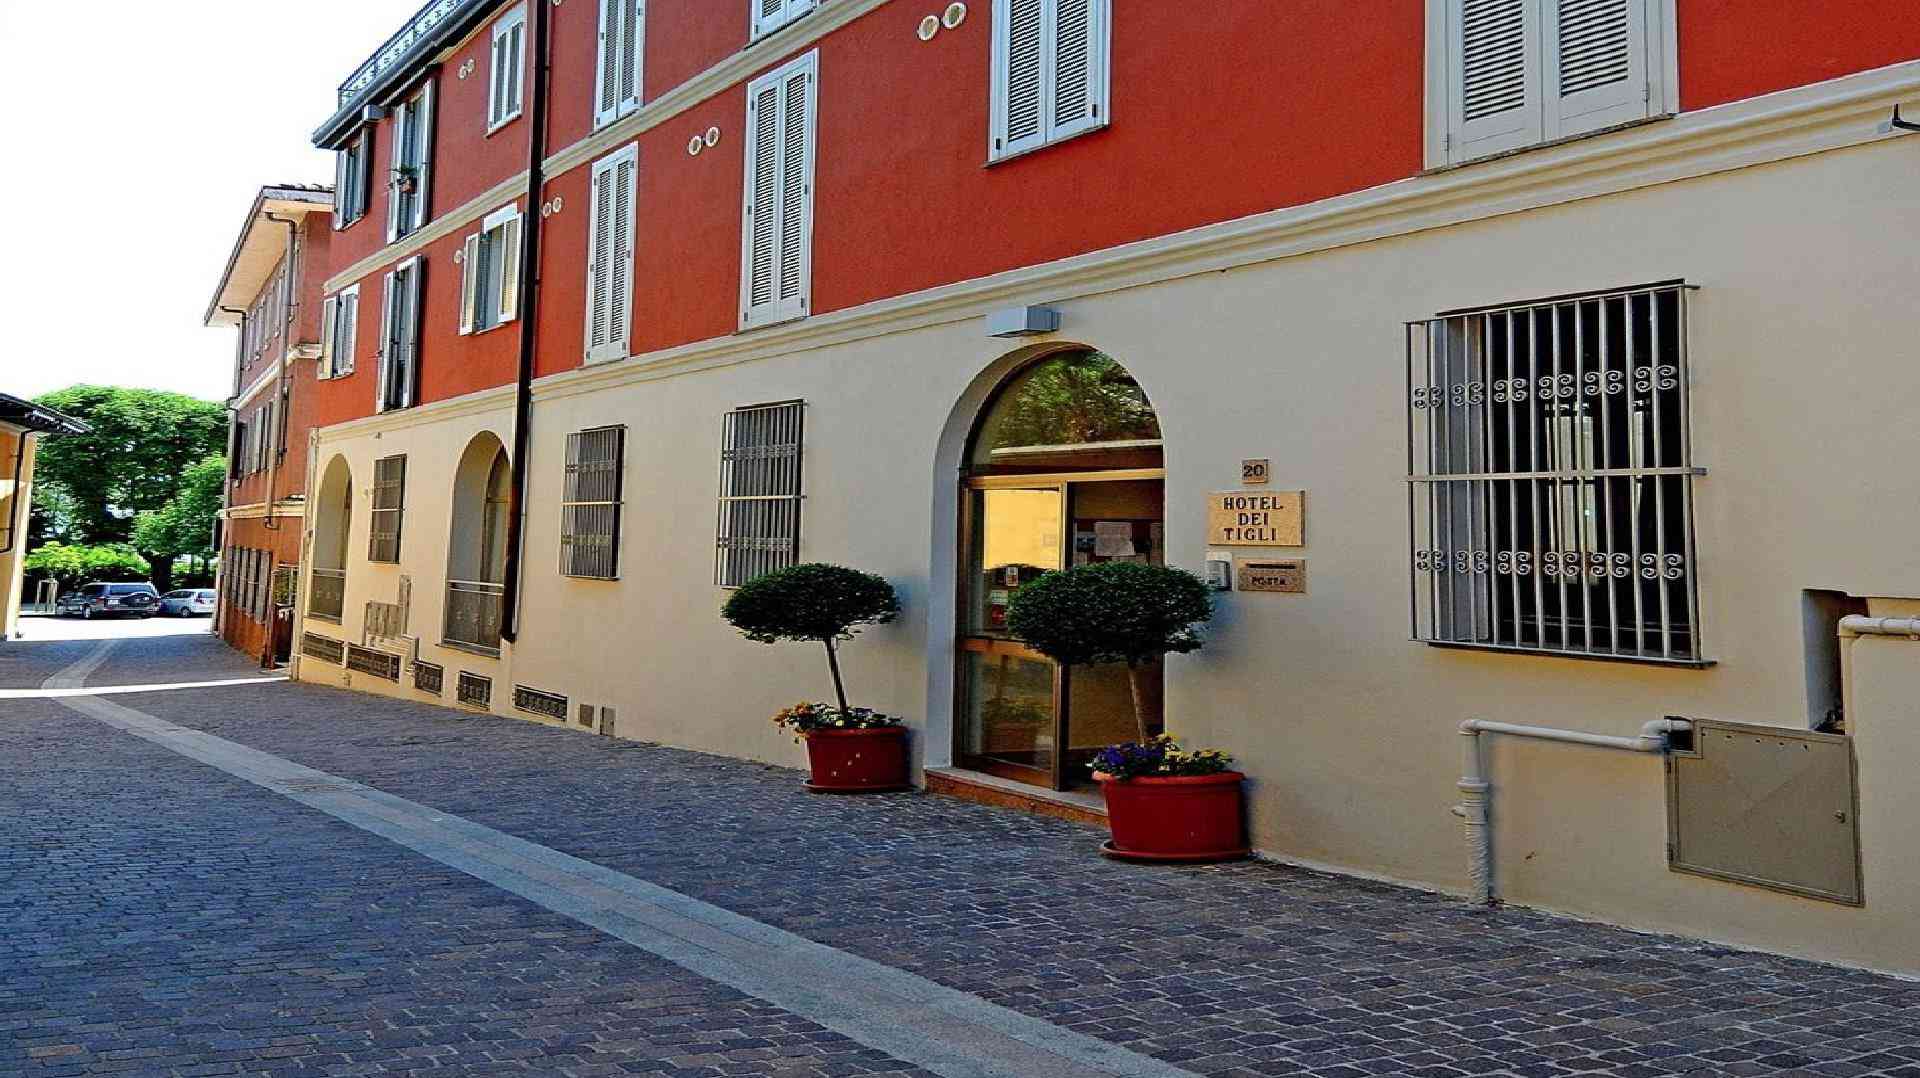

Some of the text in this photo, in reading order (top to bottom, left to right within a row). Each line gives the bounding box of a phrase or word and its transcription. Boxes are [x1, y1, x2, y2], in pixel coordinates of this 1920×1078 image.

[1243, 465, 1265, 477] 20
[1223, 497, 1283, 511] HOTEL
[1238, 513, 1269, 526] DEI
[1223, 528, 1277, 541] TIGLI
